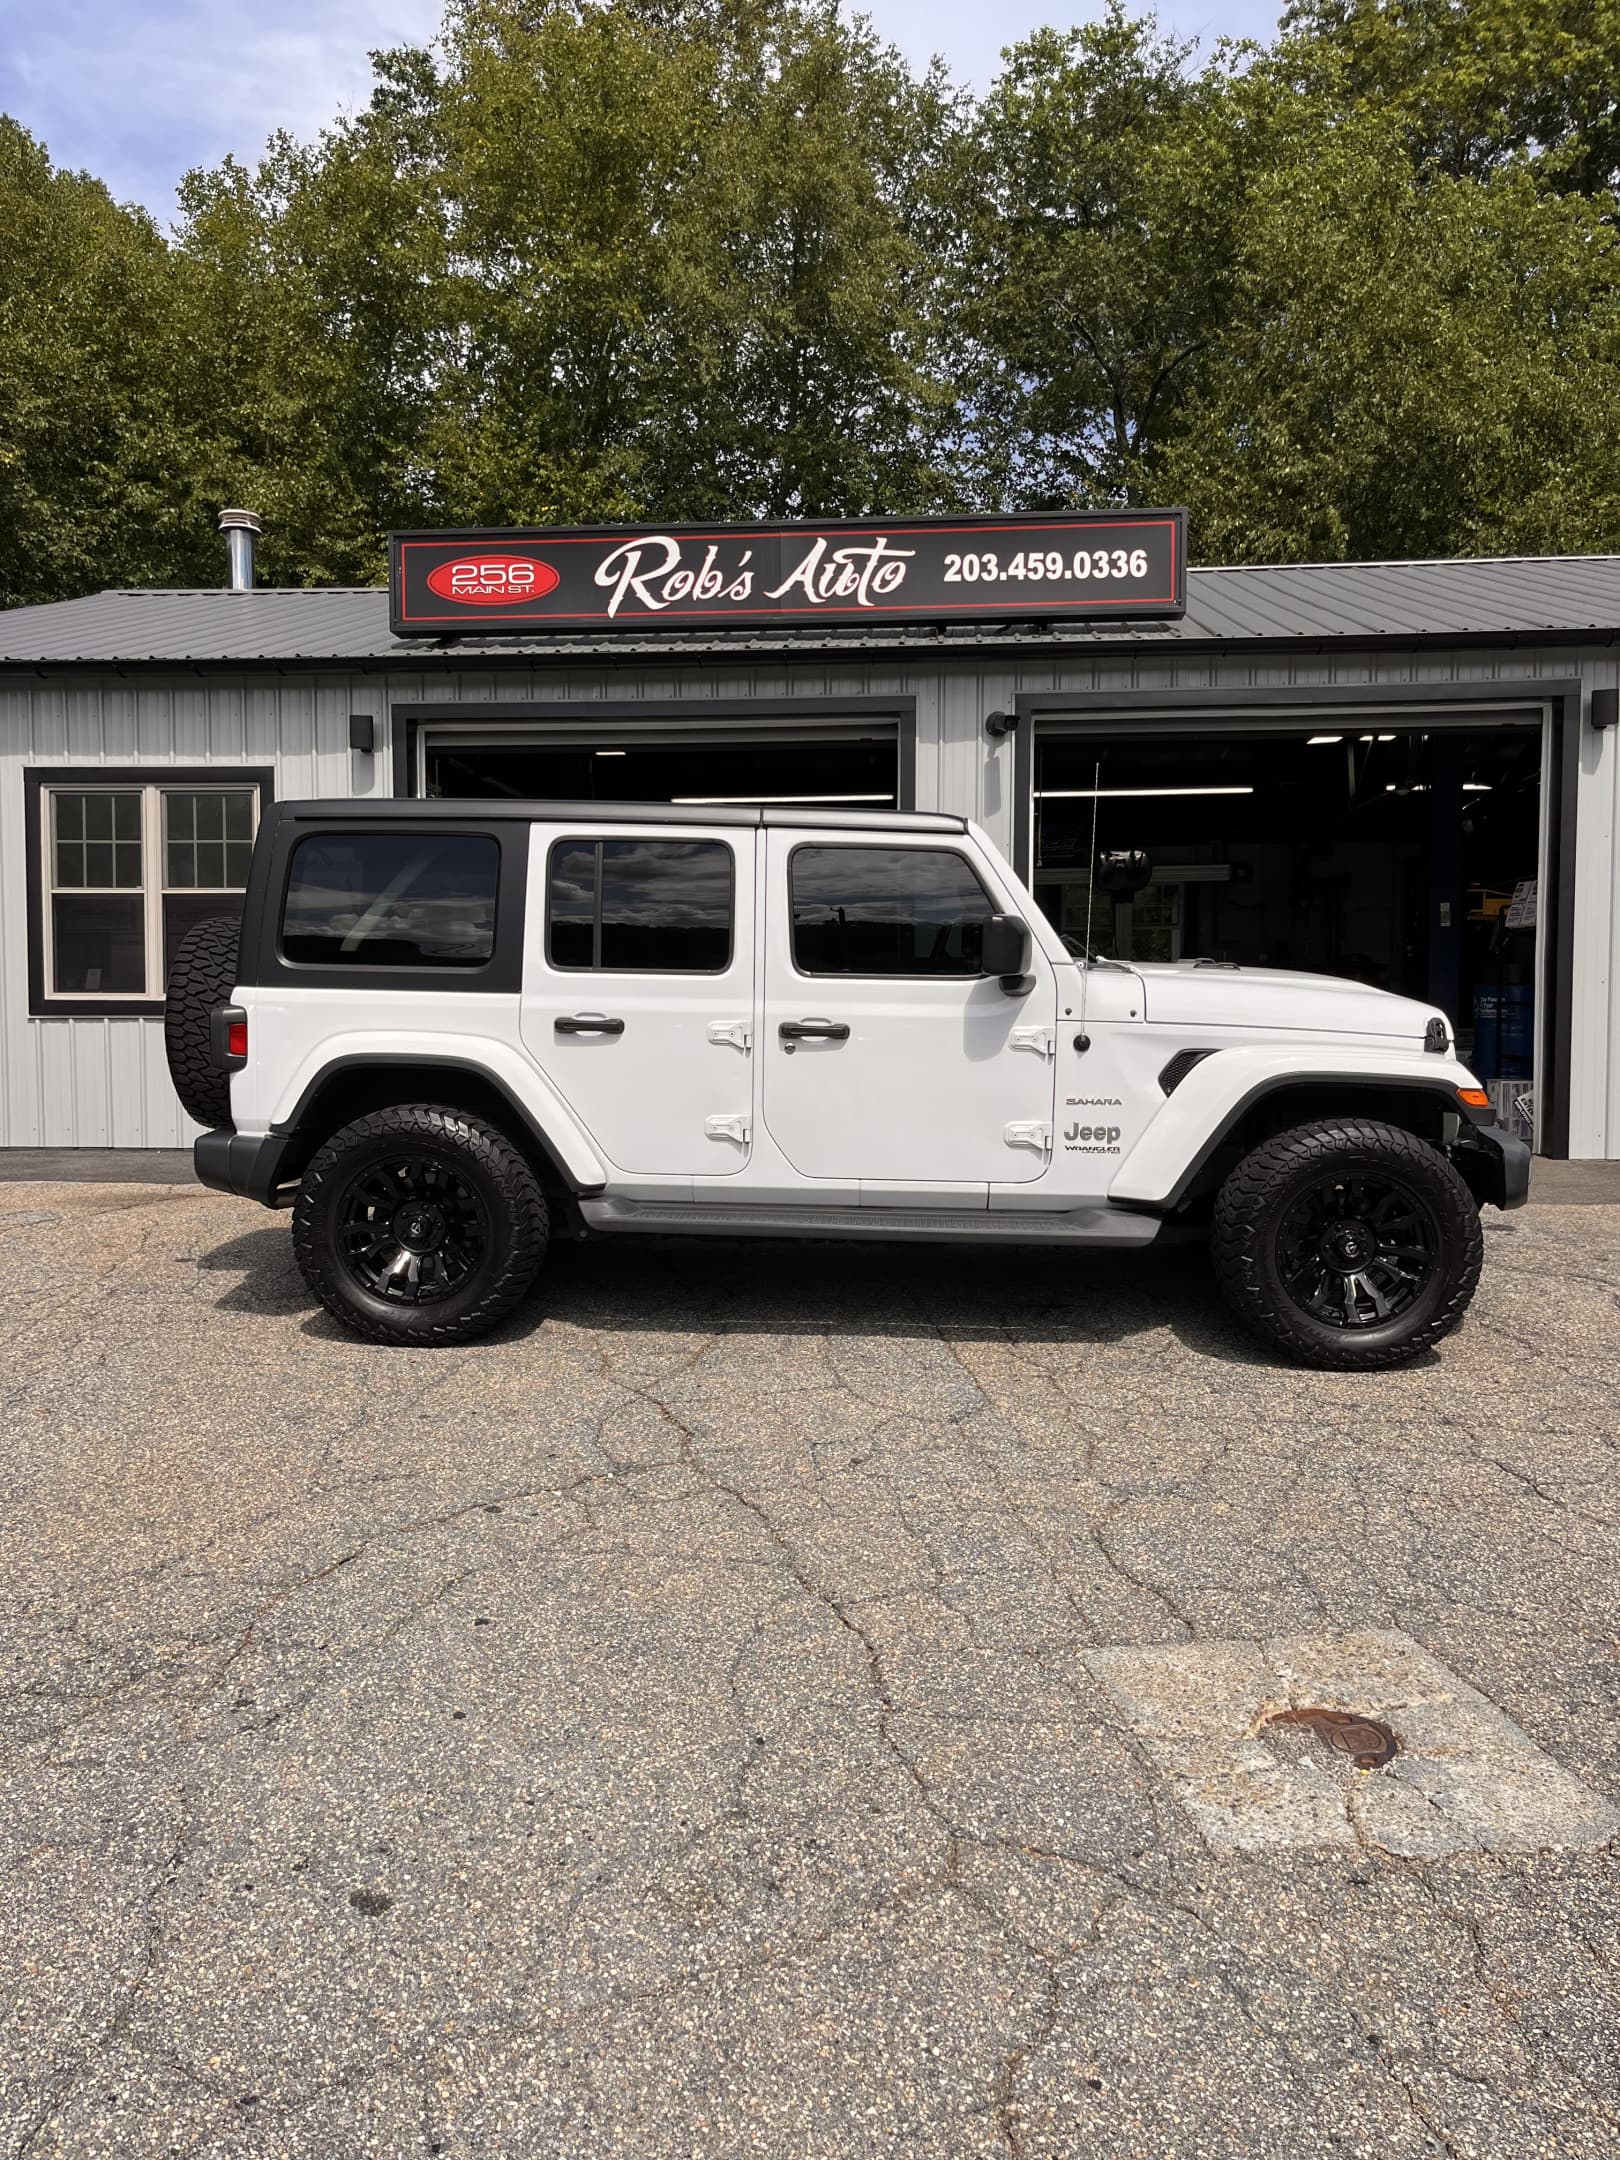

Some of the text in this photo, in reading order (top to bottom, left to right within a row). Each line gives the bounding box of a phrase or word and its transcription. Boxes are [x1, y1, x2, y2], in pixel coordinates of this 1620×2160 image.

[452, 564, 534, 585] 256
[594, 535, 915, 618] Rob's Auto
[943, 550, 1147, 582] 203.459.0336
[452, 585, 534, 594] MAIN ST.
[1066, 1098, 1122, 1106] SAHARA
[1064, 1122, 1121, 1145] Jeep
